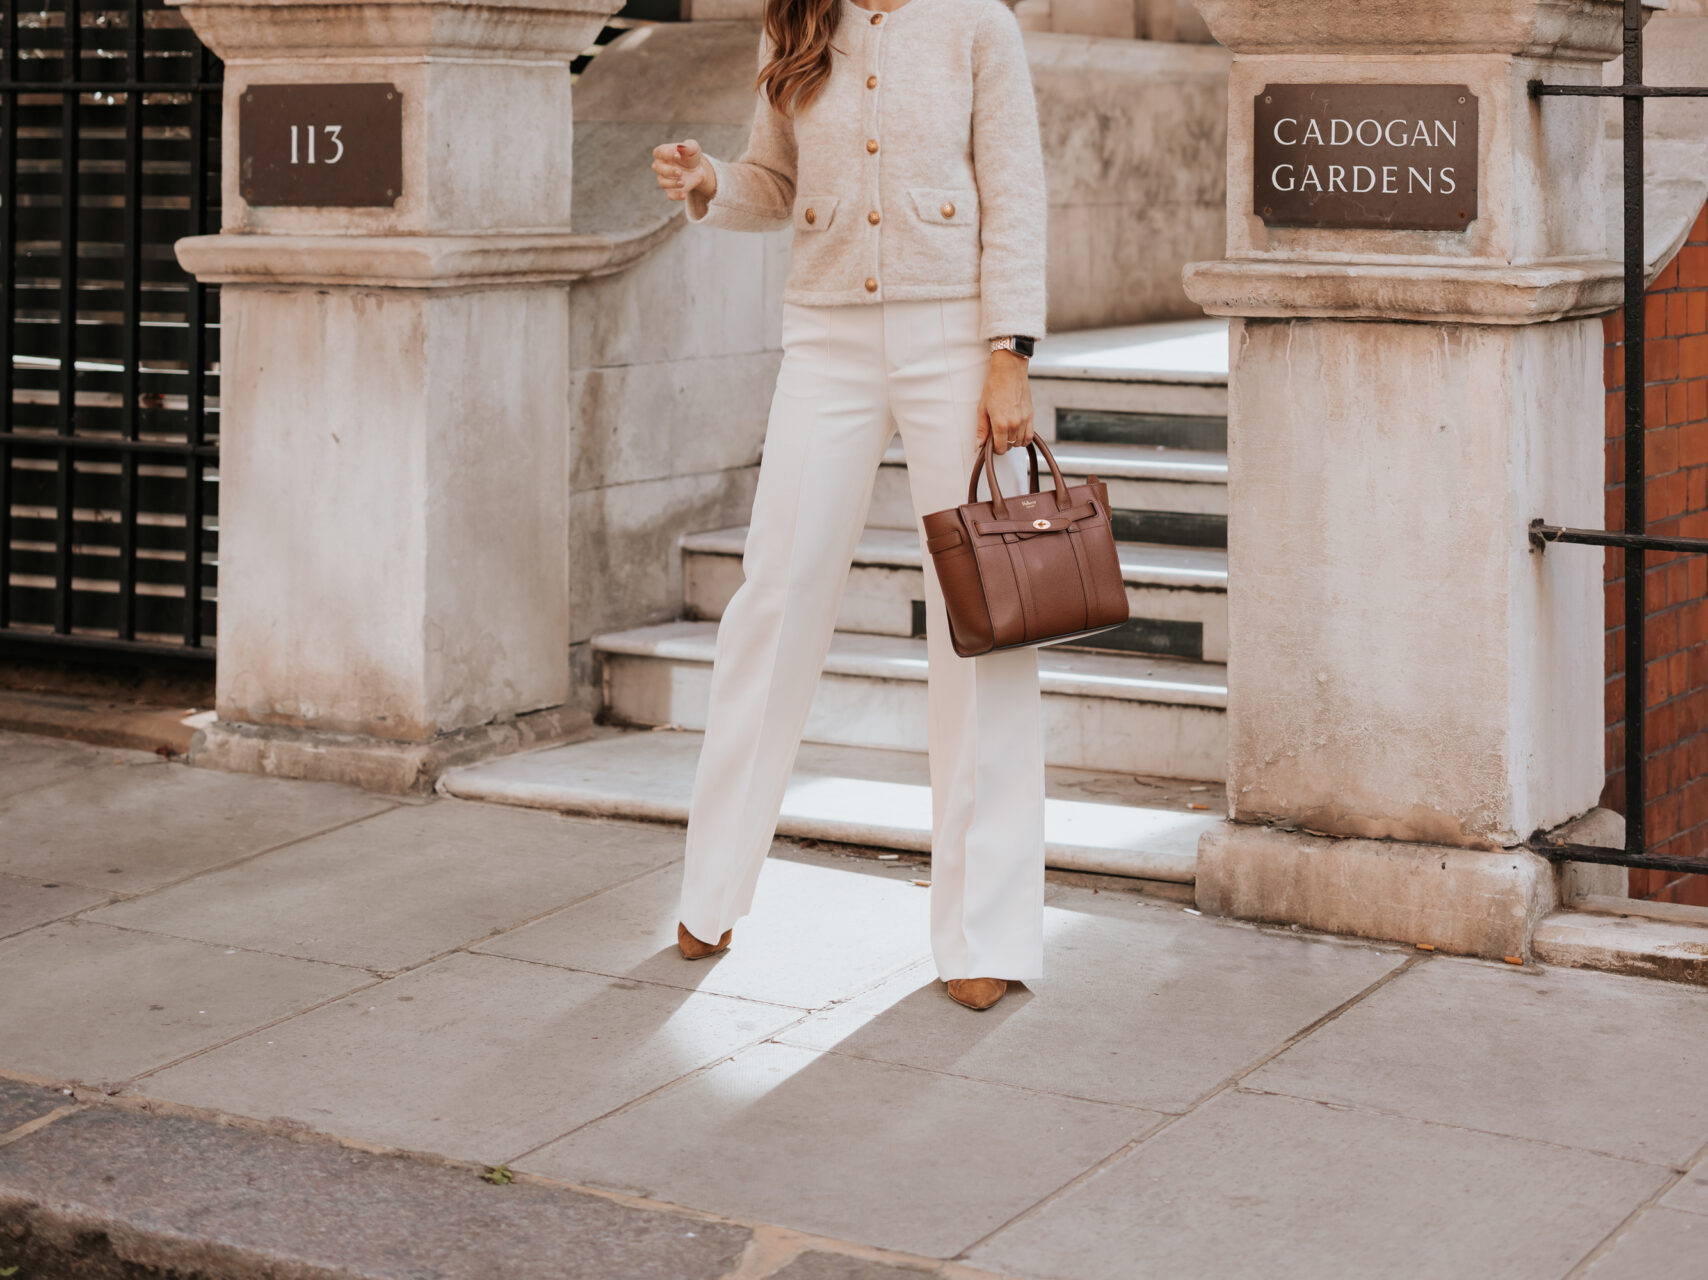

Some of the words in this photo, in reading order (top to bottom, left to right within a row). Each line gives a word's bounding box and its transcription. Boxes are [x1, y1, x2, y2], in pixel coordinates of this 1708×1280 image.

[290, 124, 345, 165] 113
[1273, 117, 1457, 148] CADOGAN
[1271, 163, 1457, 195] GARDENS
